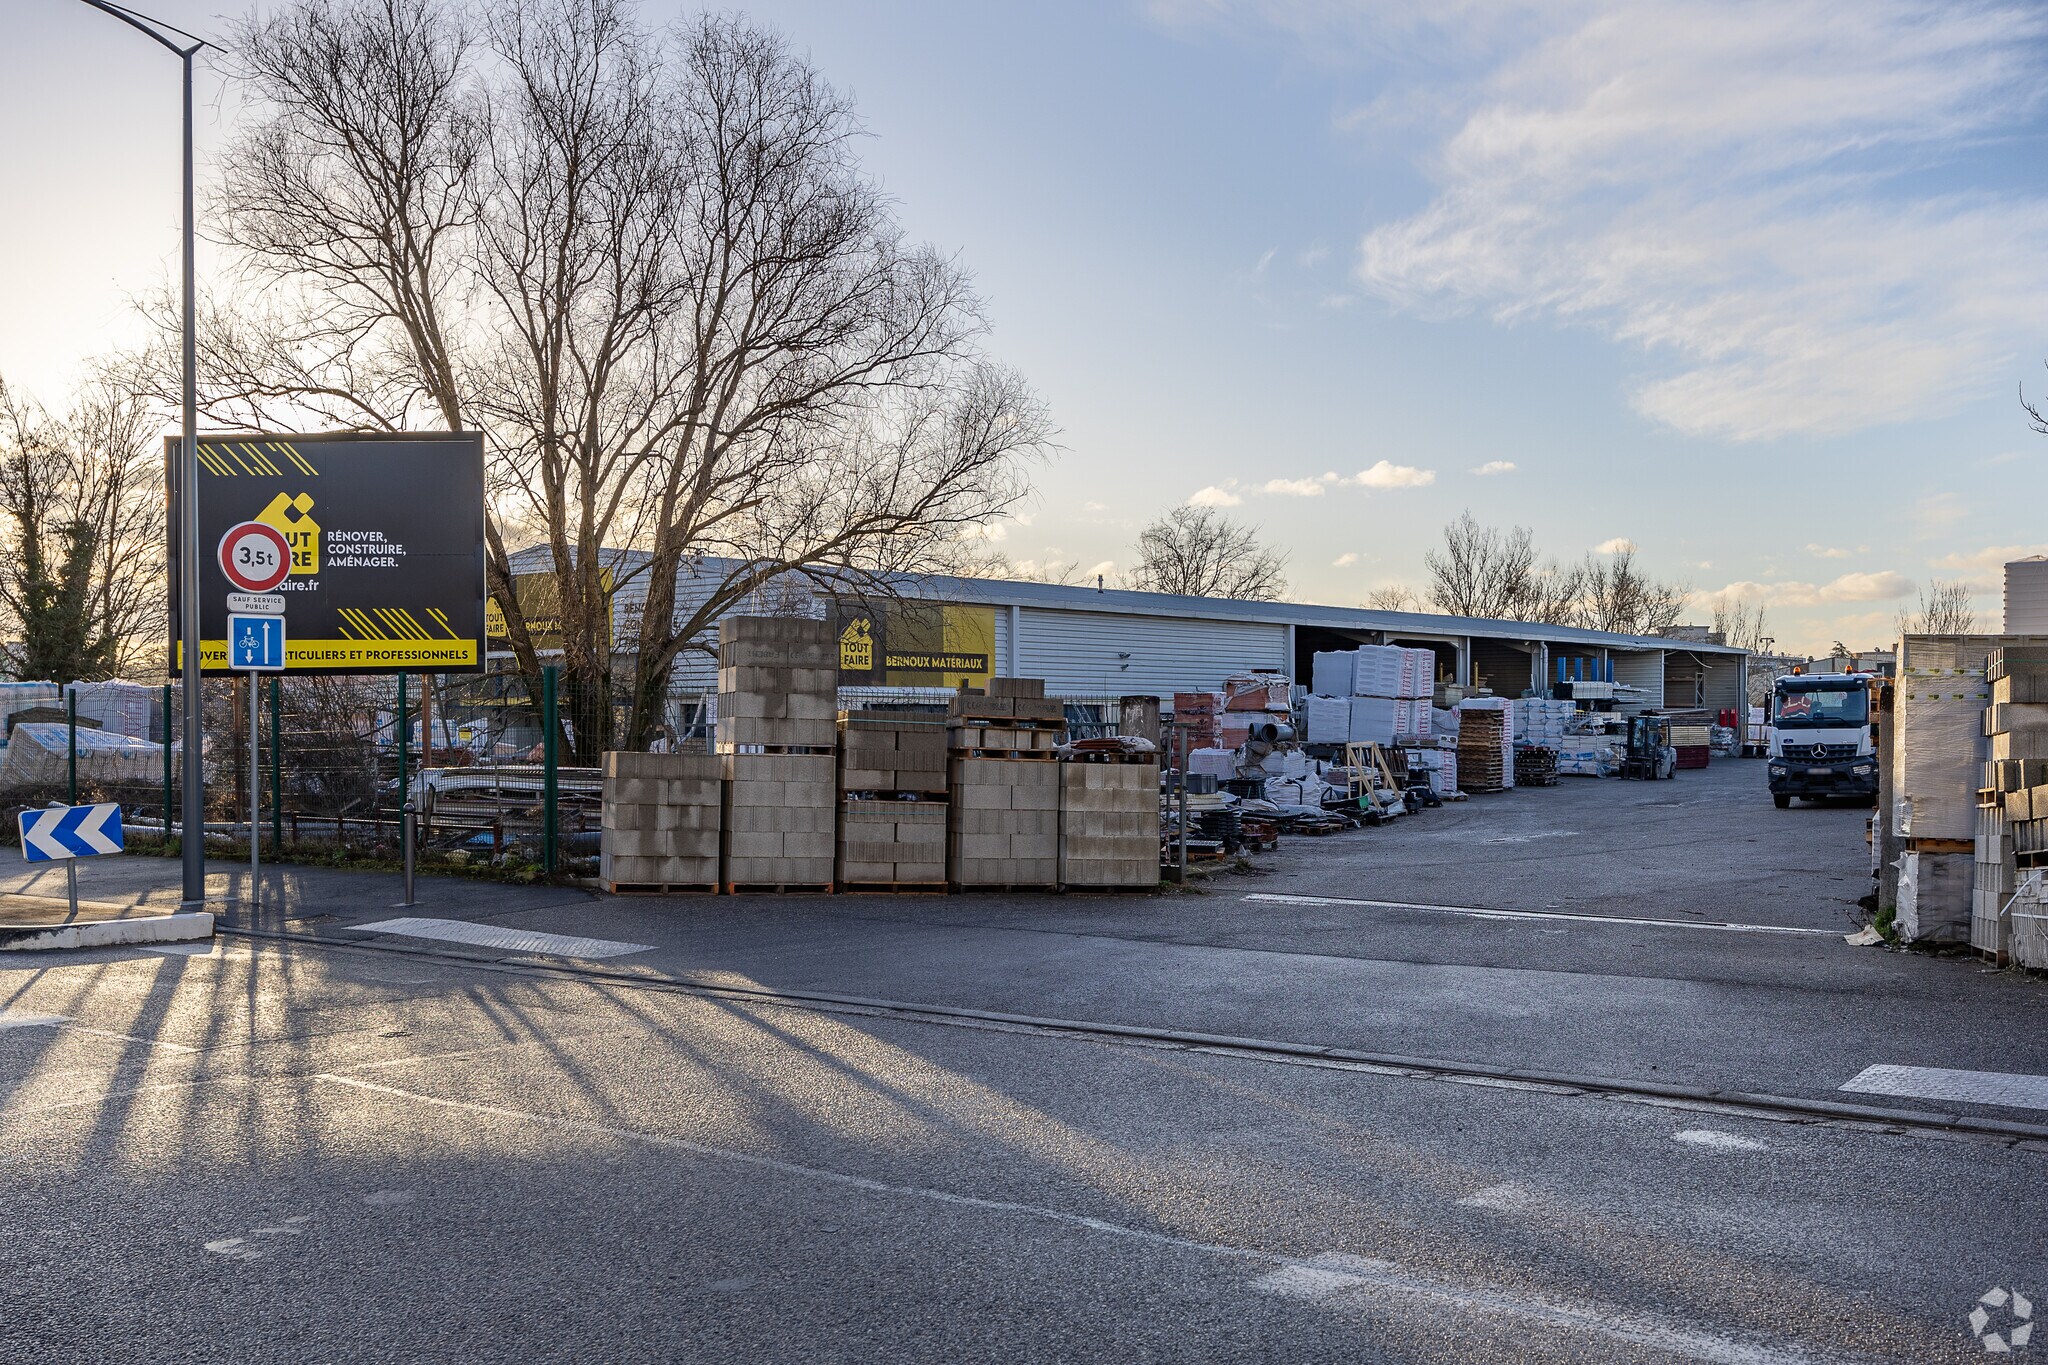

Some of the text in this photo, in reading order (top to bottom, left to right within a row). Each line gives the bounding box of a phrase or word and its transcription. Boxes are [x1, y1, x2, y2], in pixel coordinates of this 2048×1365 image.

[285, 532, 311, 548] UT
[327, 529, 388, 544] RÉNOVER,
[327, 544, 407, 556] CONSTRUIRE,
[327, 555, 399, 567] AMÉNAGER.
[275, 579, 319, 591] aire.fr
[844, 642, 869, 654] TOUT
[200, 650, 469, 660] VER TICULIERS ET PROFESSIONNELS
[844, 654, 869, 666] FAIRE
[886, 655, 983, 669] BERNOUX MATÉRIAUX
